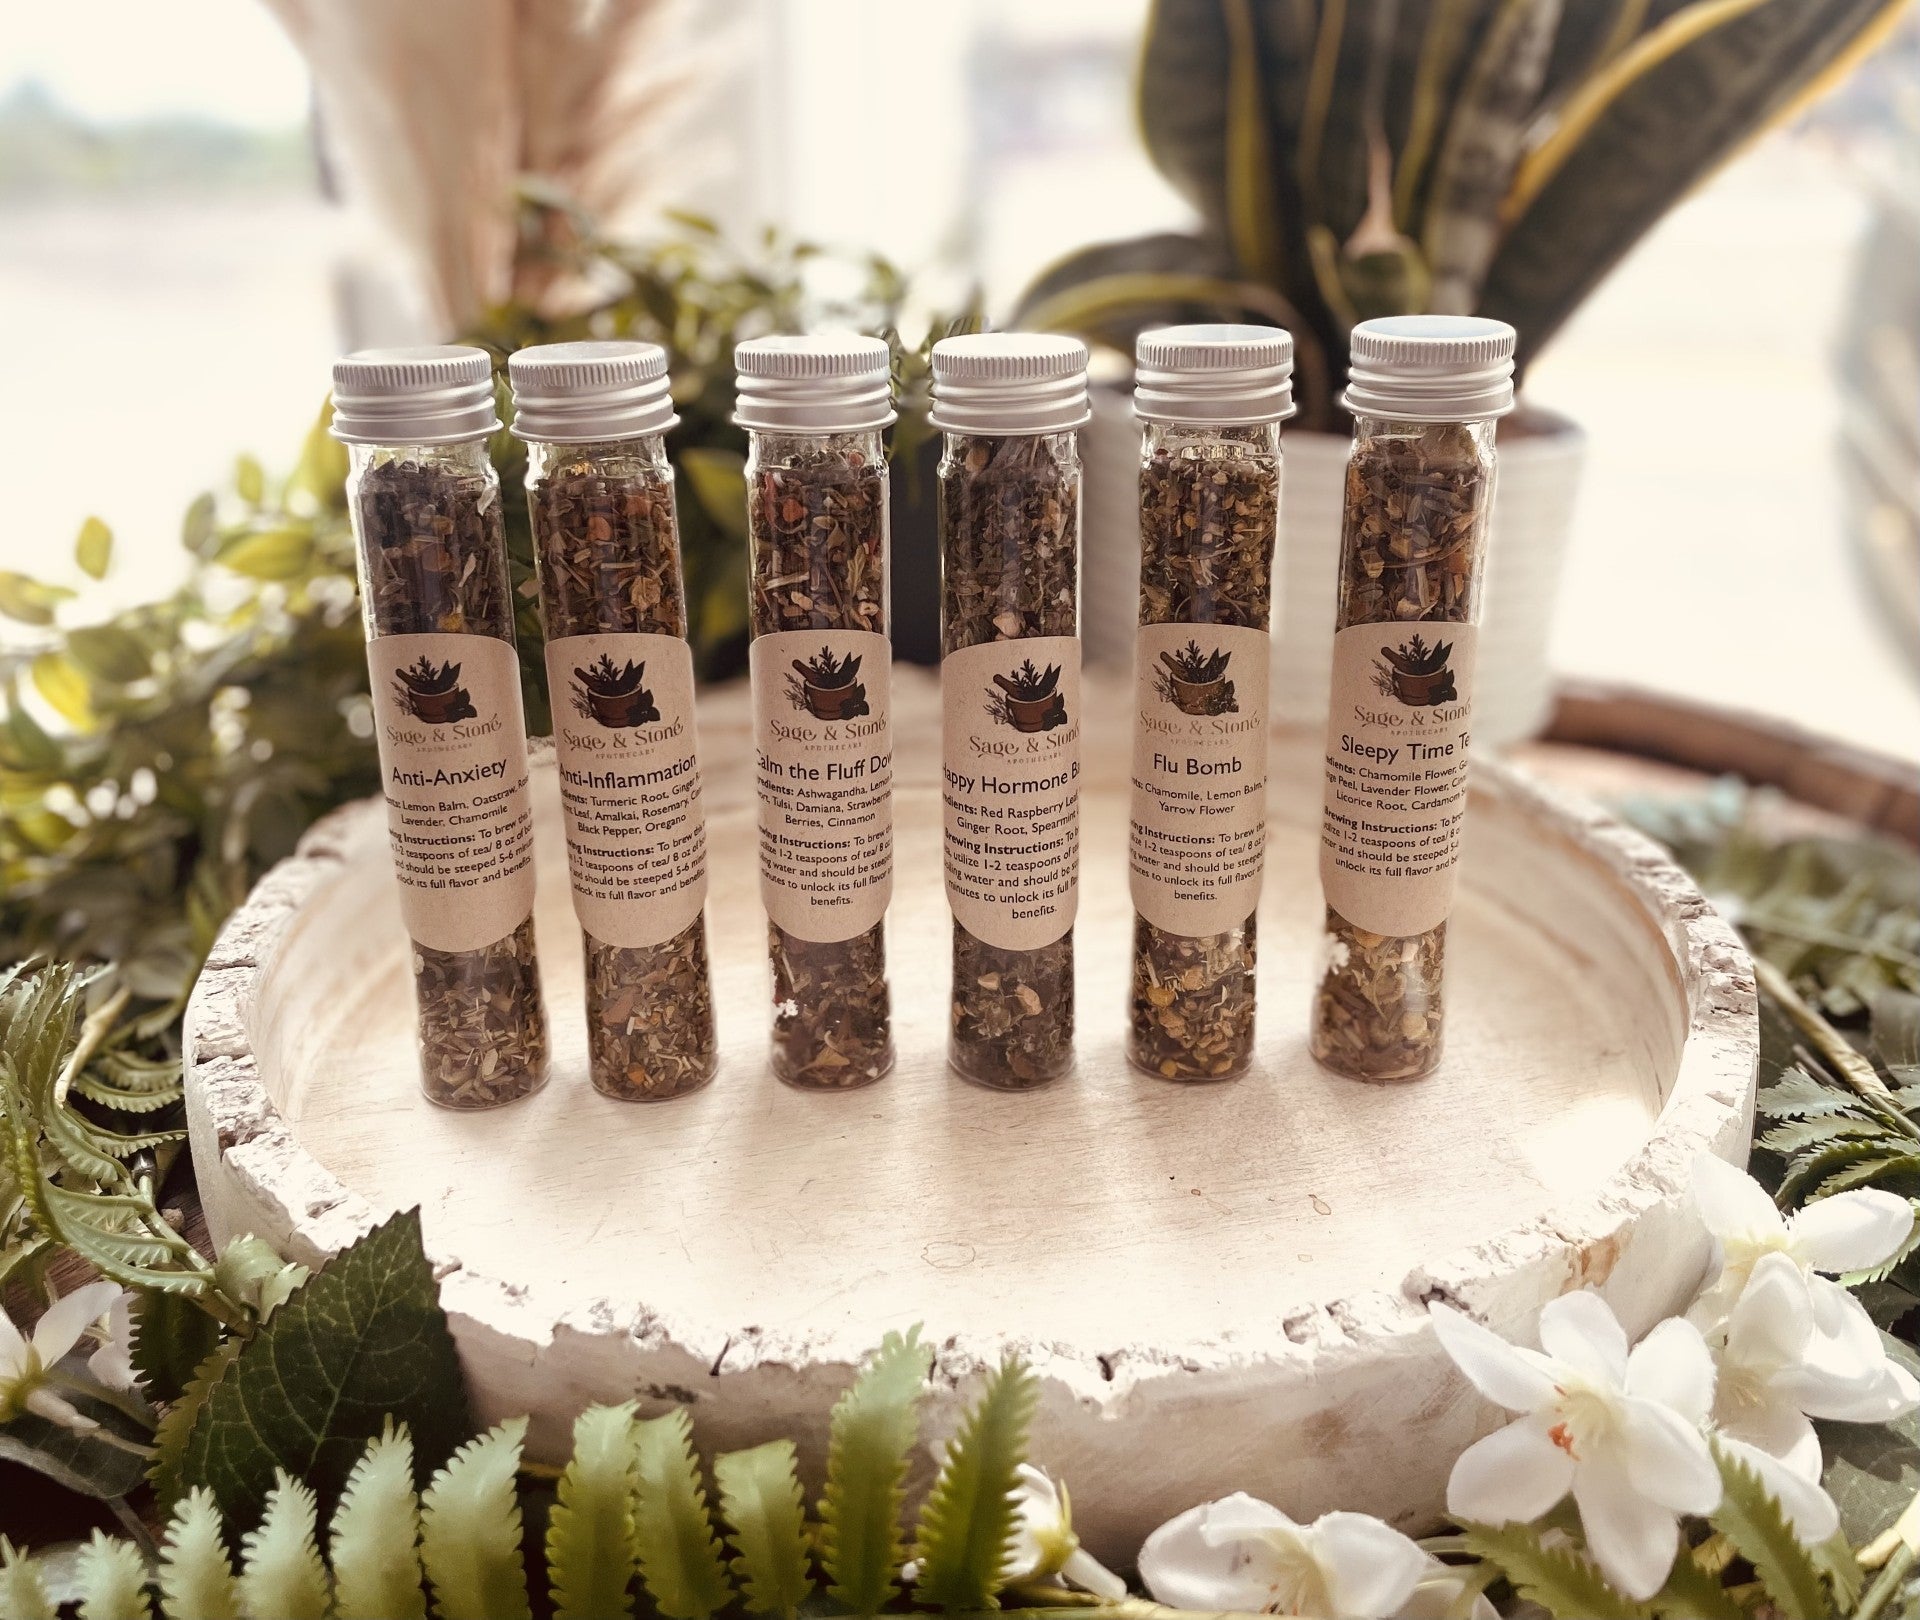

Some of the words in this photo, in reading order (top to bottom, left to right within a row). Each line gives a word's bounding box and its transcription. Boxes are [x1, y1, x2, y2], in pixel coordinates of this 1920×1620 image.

[1140, 710, 1181, 735] Sage
[1189, 720, 1203, 735] &
[1354, 705, 1404, 728] Sage
[1410, 711, 1424, 725] &
[386, 725, 426, 746] Sage
[433, 729, 445, 742] &
[563, 729, 606, 751] Sage
[613, 733, 627, 748] &
[770, 720, 816, 742] Sage
[824, 726, 837, 740] &
[1391, 727, 1448, 736] APOTHECARY
[595, 748, 655, 760] APOTHECARY
[970, 735, 1019, 758] Sage
[1026, 738, 1039, 753] &
[1342, 734, 1399, 765] Sleepy
[1407, 743, 1454, 760] Time
[1459, 732, 1469, 749] Te
[393, 759, 506, 786] Anti-Anxiety
[560, 754, 696, 788] Anti-Inflammation
[789, 763, 819, 780] the
[827, 759, 865, 781] Fluff
[870, 750, 892, 774] Dow
[1154, 753, 1178, 774] Flu
[1187, 757, 1242, 775] Bomb
[982, 772, 1068, 794] Hormone
[1359, 768, 1422, 781] Chamomile
[1425, 768, 1457, 780] Flower,
[590, 796, 637, 806] Turmeric
[641, 791, 669, 803] Root,
[672, 778, 695, 796] Ginger
[797, 787, 867, 801] Ashwagandha,
[1145, 783, 1202, 801] Chamomile,
[1207, 790, 1241, 800] Lemon
[1339, 776, 1358, 790] Peel,
[1361, 783, 1410, 796] Lavender
[1415, 783, 1449, 795] Flower,
[403, 801, 435, 812] Lemon
[439, 802, 469, 811] Balm,
[473, 787, 517, 806] Oatstraw,
[773, 796, 793, 811] Tulsi,
[796, 802, 844, 813] Damiana,
[1159, 801, 1196, 814] Yarrow
[1200, 805, 1235, 814] Flower
[1337, 790, 1372, 808] Licorice
[1376, 801, 1407, 811] Root,
[1412, 793, 1460, 810] Cardamom
[401, 814, 445, 826] Lavender,
[449, 805, 508, 825] Chamomile
[595, 811, 639, 821] Amalkai,
[643, 799, 689, 819] Rosemary,
[785, 814, 823, 828] Berries,
[828, 812, 875, 827] Cinnamon
[981, 806, 1003, 818] Red
[1008, 802, 1063, 820] Raspberry
[1325, 806, 1358, 830] Brewing
[1362, 821, 1437, 834] Instructions:
[1441, 818, 1450, 827] To
[404, 834, 475, 845] Instructions:
[478, 830, 492, 839] To
[495, 817, 516, 834] brew
[578, 822, 600, 834] Black
[603, 826, 642, 838] Pepper,
[645, 814, 686, 832] Oregano
[957, 817, 990, 834] Ginger
[995, 824, 1028, 835] Root,
[1032, 810, 1076, 835] Spearmint
[584, 845, 654, 857] Instructions:
[657, 842, 670, 851] To
[673, 833, 693, 848] brew
[780, 836, 850, 850] Instructions:
[854, 837, 864, 846] To
[868, 831, 885, 843] brew
[945, 827, 980, 854] Brewing
[984, 837, 1064, 855] Instructions:
[1065, 830, 1073, 842] To
[1145, 826, 1215, 844] Instructions:
[1219, 834, 1231, 842] To
[1234, 827, 1254, 840] brew
[1360, 837, 1415, 848] teaspoons
[1420, 837, 1431, 846] of
[406, 850, 454, 861] teaspoons
[458, 850, 469, 859] of
[406, 864, 434, 874] should
[438, 865, 451, 874] be
[455, 859, 496, 873] steeped
[500, 850, 513, 863] 5-6
[796, 854, 847, 865] teaspoons
[851, 852, 860, 861] of
[954, 851, 979, 867] utilize
[984, 859, 1001, 870] 1-2
[1006, 856, 1061, 871] teaspoons
[1064, 847, 1072, 859] of
[1138, 852, 1160, 867] water
[1163, 861, 1181, 871] and
[1185, 862, 1220, 872] should
[1223, 861, 1234, 870] be
[1160, 847, 1211, 859] teaspoons
[1216, 847, 1227, 857] of
[1339, 845, 1354, 856] and
[1358, 850, 1392, 862] should
[1396, 853, 1409, 862] be
[1413, 846, 1448, 862] steeped
[585, 874, 613, 886] should
[617, 877, 629, 886] be
[633, 870, 673, 885] steeped
[676, 862, 689, 875] 5-6
[586, 862, 634, 872] teaspoons
[638, 861, 649, 870] of
[773, 861, 796, 875] water
[800, 868, 817, 878] and
[822, 866, 855, 878] should
[858, 862, 868, 873] be
[964, 872, 994, 886] water
[998, 877, 1019, 887] and
[1023, 870, 1058, 887] should
[1062, 865, 1070, 876] be
[1336, 858, 1366, 873] unlock
[1369, 867, 1382, 875] its
[1386, 868, 1401, 877] full
[1405, 865, 1433, 877] flavor
[1436, 859, 1450, 872] and
[417, 879, 427, 887] its
[430, 879, 445, 888] full
[450, 878, 479, 888] flavor
[483, 872, 501, 883] and
[788, 880, 798, 890] to
[800, 880, 835, 892] unlock
[838, 882, 850, 891] its
[853, 877, 867, 888] full
[1152, 872, 1162, 882] to
[1165, 875, 1199, 887] unlock
[1202, 877, 1214, 886] its
[1218, 874, 1232, 886] full
[1235, 867, 1256, 882] flavor
[596, 888, 606, 898] its
[609, 890, 624, 900] full
[628, 888, 656, 899] flavor
[660, 883, 677, 894] and
[810, 897, 853, 906] benefits.
[983, 892, 995, 902] to
[1000, 891, 1039, 903] unlock
[1042, 888, 1054, 899] its
[1057, 881, 1068, 894] full
[1174, 891, 1217, 900] benefits.
[1012, 907, 1057, 919] benefits.
